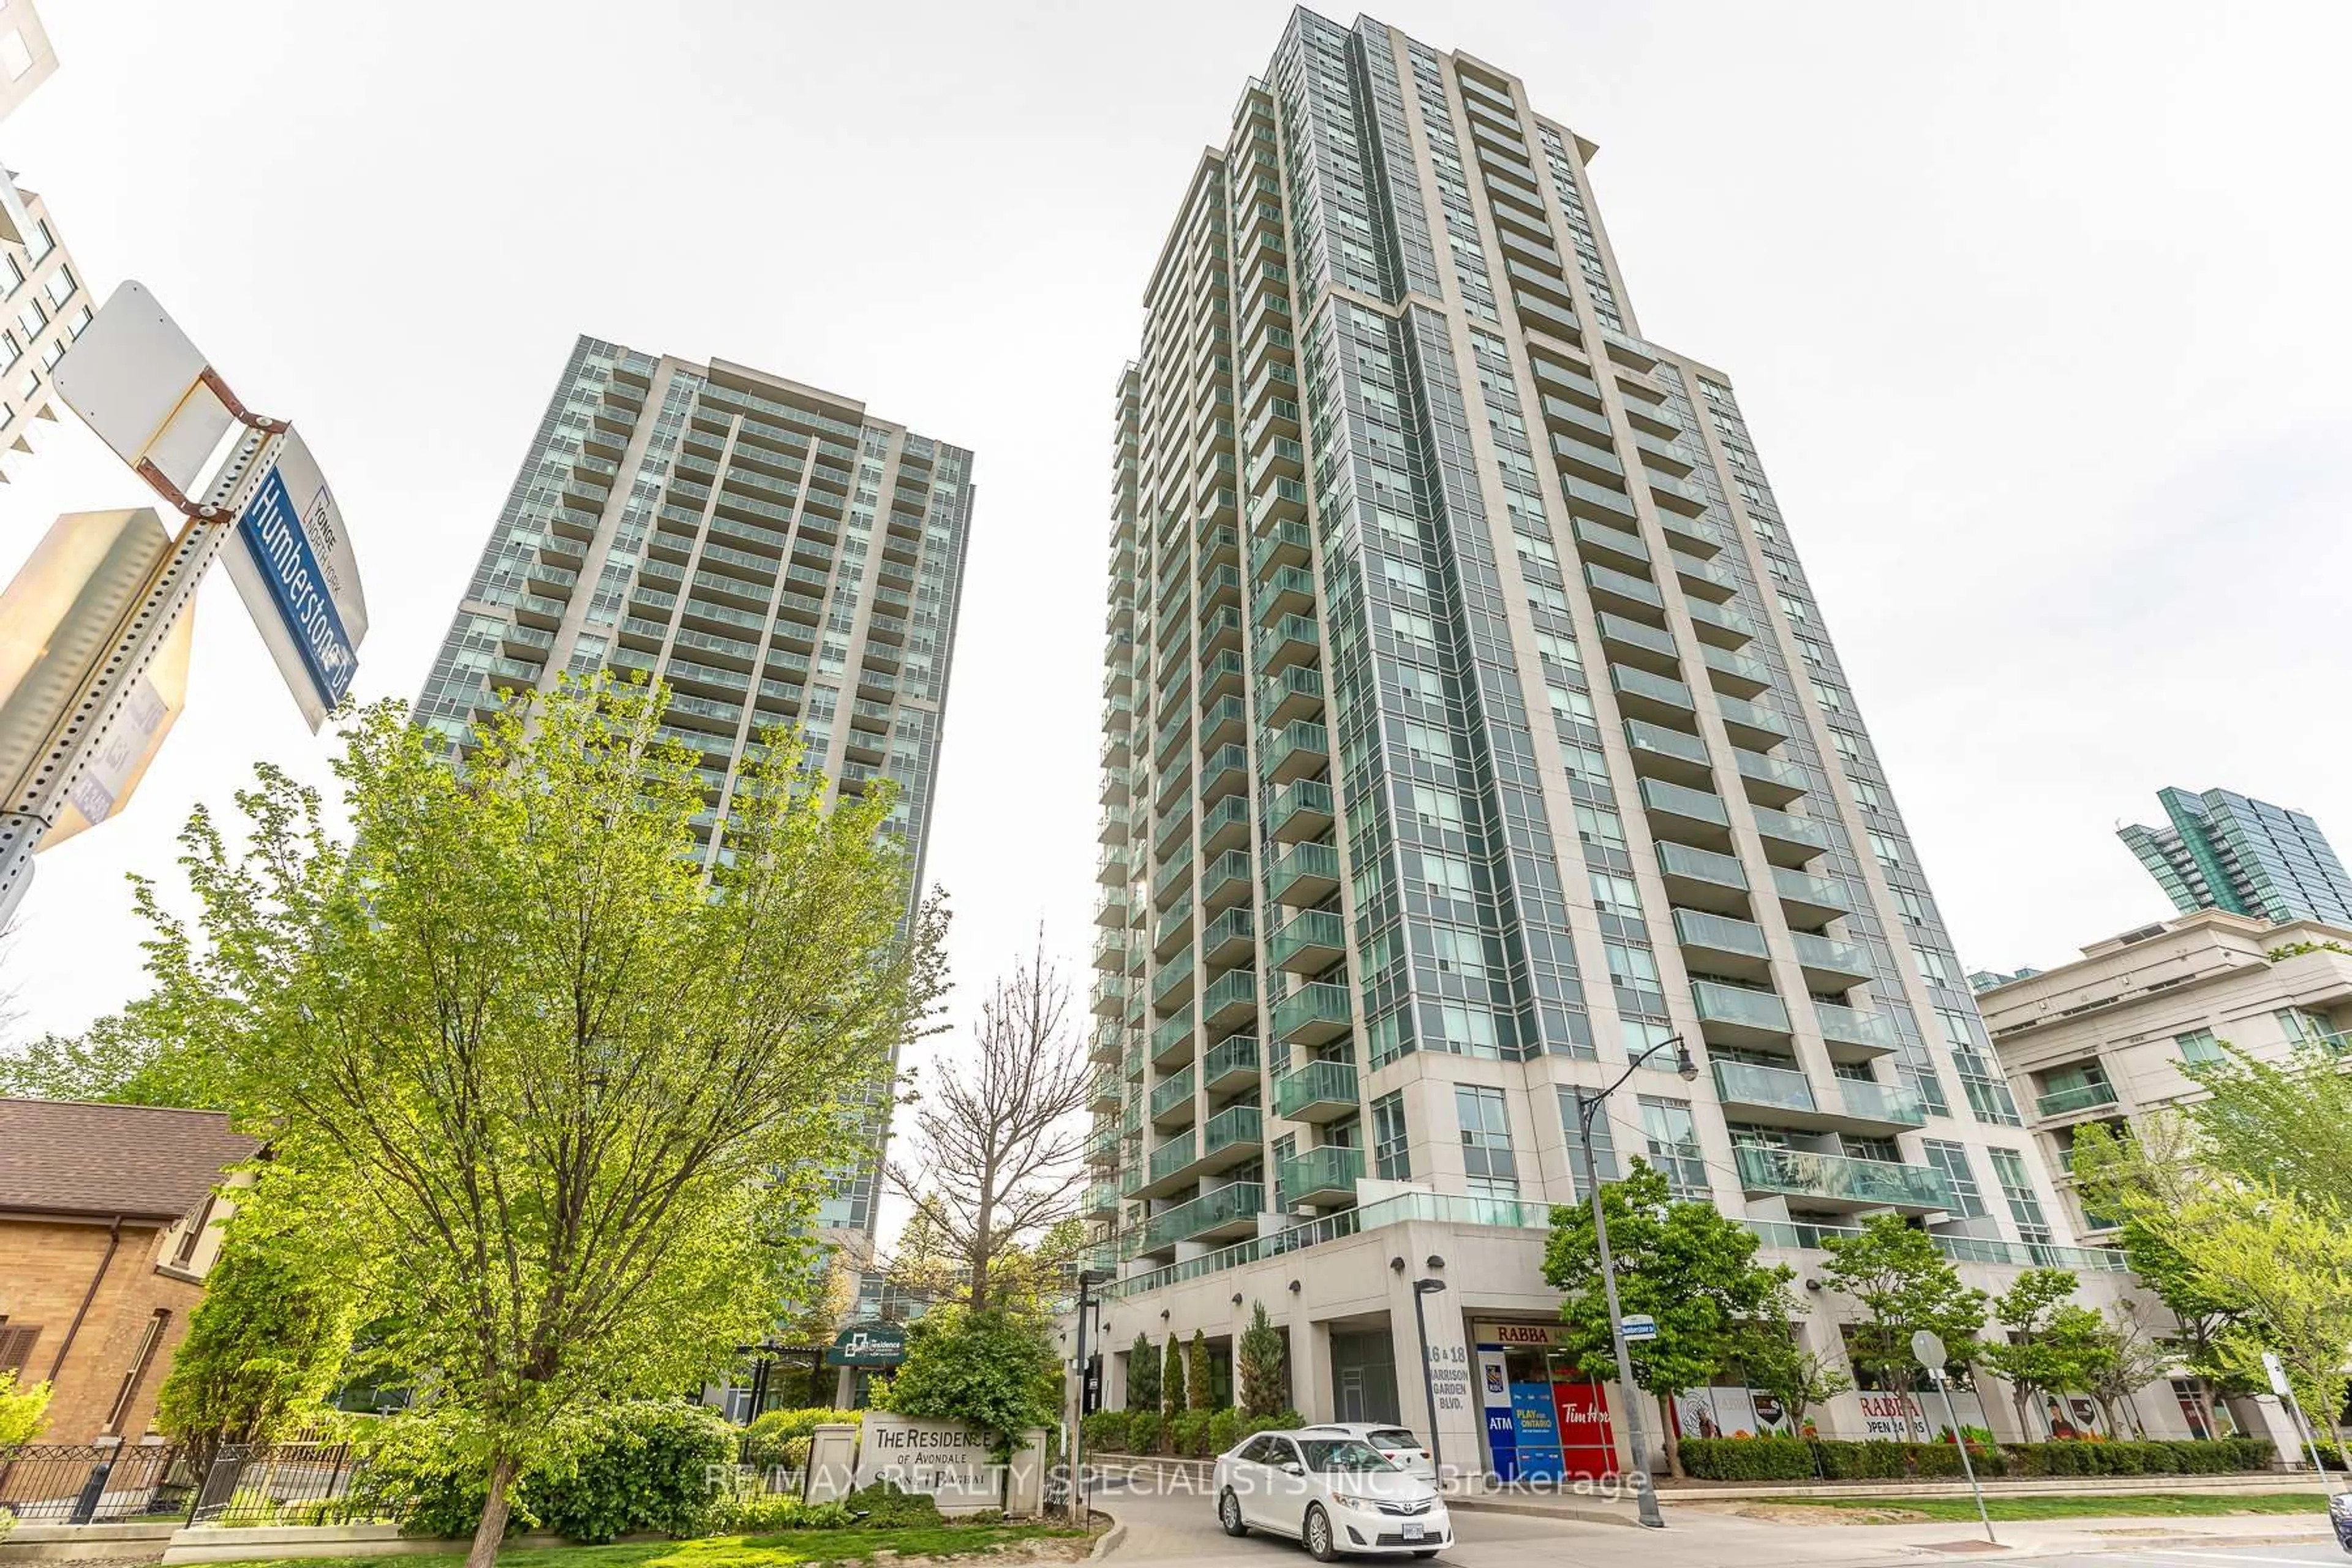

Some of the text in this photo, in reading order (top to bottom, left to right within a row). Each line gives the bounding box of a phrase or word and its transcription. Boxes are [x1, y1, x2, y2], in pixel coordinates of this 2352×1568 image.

[314, 501, 336, 552] YONGE
[306, 517, 341, 595] NORTH YORK
[252, 478, 341, 670] Humberstone
[1498, 1327, 1548, 1342] RABBA
[1450, 1346, 1465, 1363] 18
[1433, 1383, 1466, 1395] GARDEN
[1439, 1398, 1463, 1409] BLVD.
[1516, 1410, 1536, 1419] PLAY
[1562, 1403, 1586, 1423] Tim
[1490, 1417, 1512, 1430] ATM
[876, 1429, 904, 1448] THE
[898, 1453, 967, 1464] OF AVONDALE
